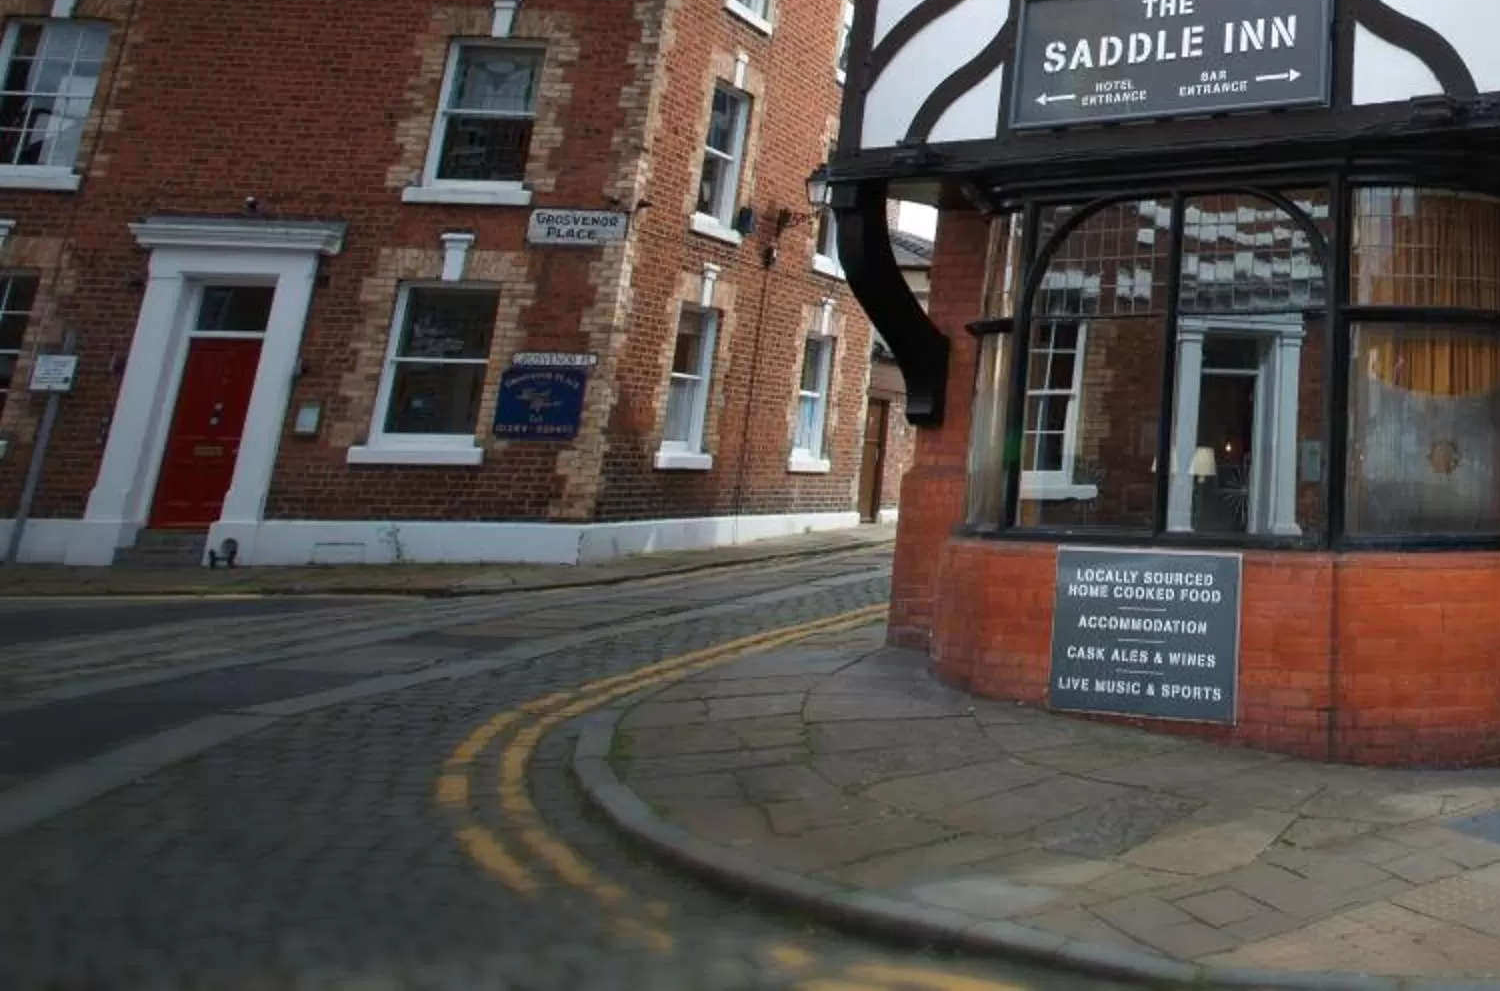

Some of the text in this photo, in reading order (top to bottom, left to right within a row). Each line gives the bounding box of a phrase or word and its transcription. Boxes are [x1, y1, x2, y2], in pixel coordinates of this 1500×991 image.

[1043, 14, 1297, 73] SADDLE INN
[1200, 69, 1228, 83] BAR
[1095, 79, 1134, 92] HOTEL
[1179, 80, 1248, 97] ENTRANCE
[1081, 89, 1148, 107] ENTRANCE
[535, 211, 620, 228] GROSVENOR
[546, 227, 597, 241] PLACE
[1077, 568, 1214, 587] LOCALLY SOURCED
[1068, 584, 1221, 603] HOME COOKED FOOD
[1078, 614, 1207, 635] ACCOMMODATION
[1067, 645, 1216, 668] CASK ALES & WINES
[1058, 677, 1222, 702] LIVE MUSIC & SPORTS
